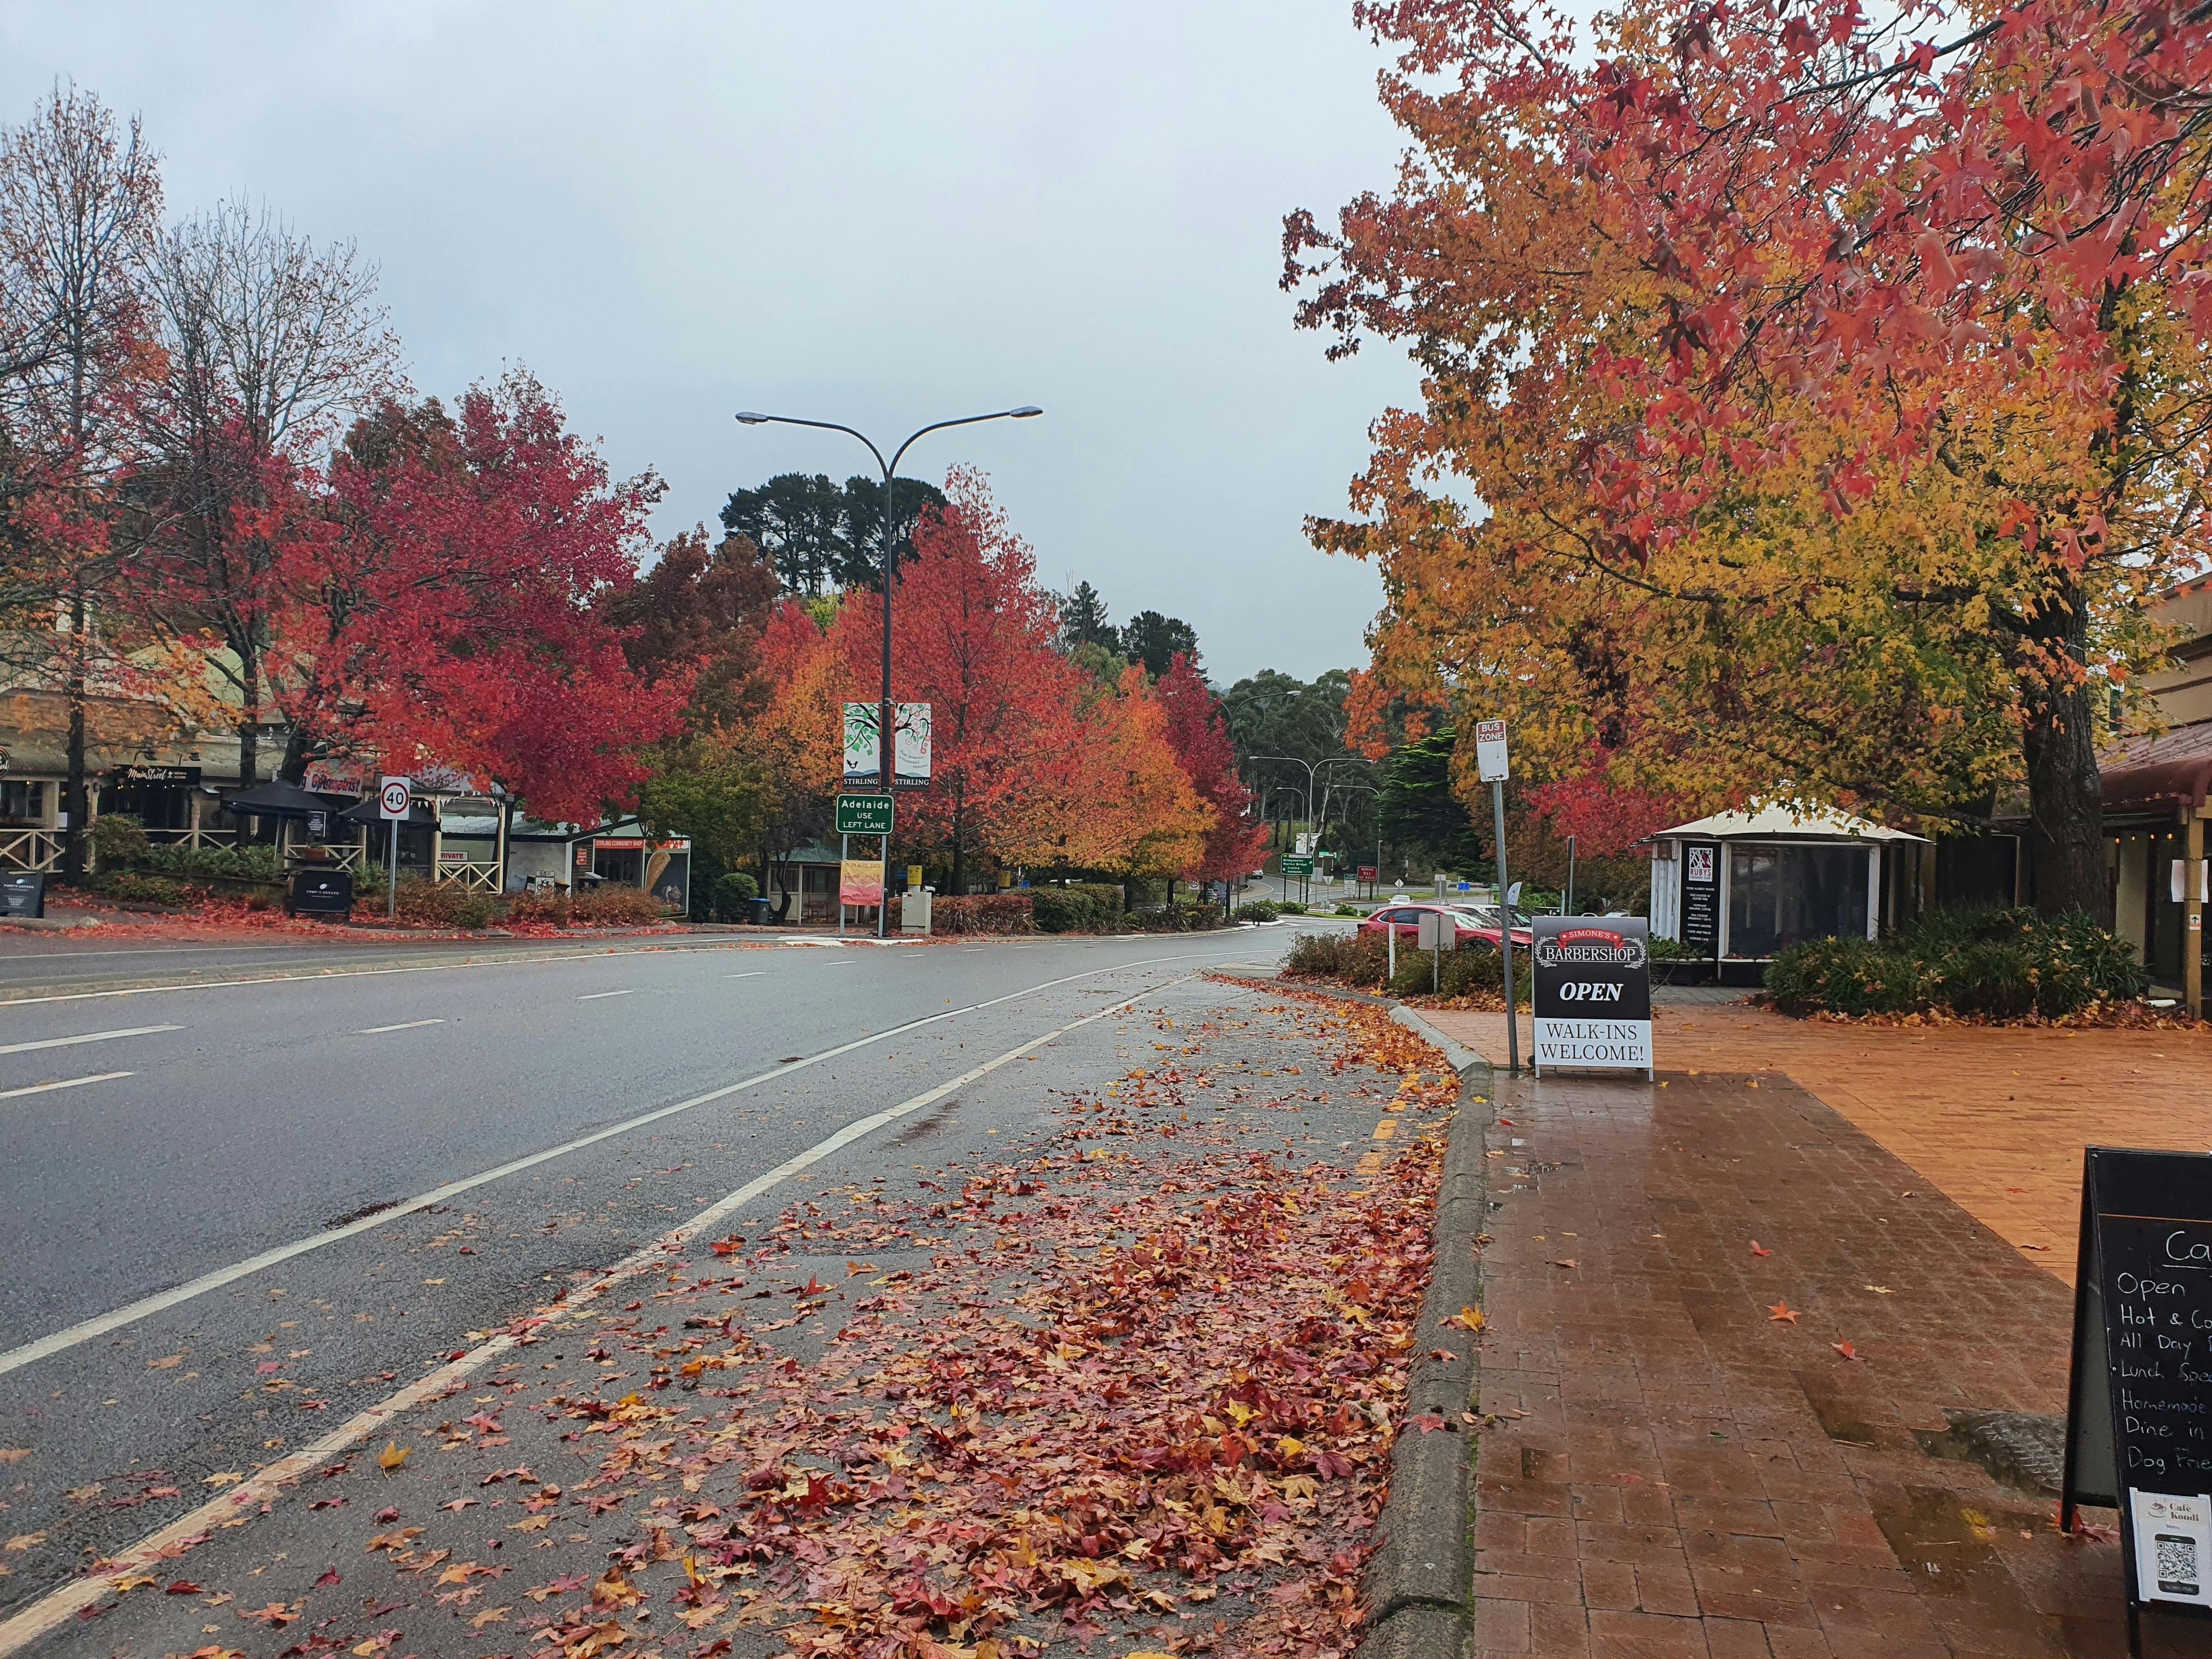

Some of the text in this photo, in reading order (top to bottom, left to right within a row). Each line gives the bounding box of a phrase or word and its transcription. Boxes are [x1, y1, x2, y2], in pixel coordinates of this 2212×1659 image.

[1481, 723, 1500, 732] BUS
[1479, 732, 1504, 742] ZONE
[146, 768, 167, 781] Street
[386, 792, 404, 805] 40
[841, 799, 889, 809] Adelaide
[1568, 930, 1611, 939] SIMONE'S
[1546, 947, 1635, 961] BARBERSHOP
[1560, 982, 1624, 1001] OPEN
[1545, 1023, 1637, 1040] WALK-INS
[1539, 1043, 1644, 1061] WELCOME!
[2118, 1272, 2186, 1301] Open
[2120, 1304, 2155, 1326] Hot
[2170, 1313, 2183, 1327] &
[2120, 1332, 2141, 1348] All
[2158, 1334, 2191, 1361] Day
[2121, 1359, 2164, 1379] Lunch
[2122, 1388, 2207, 1414] Homemade
[2126, 1416, 2204, 1440] Dine in
[2128, 1446, 2166, 1475] Dog
